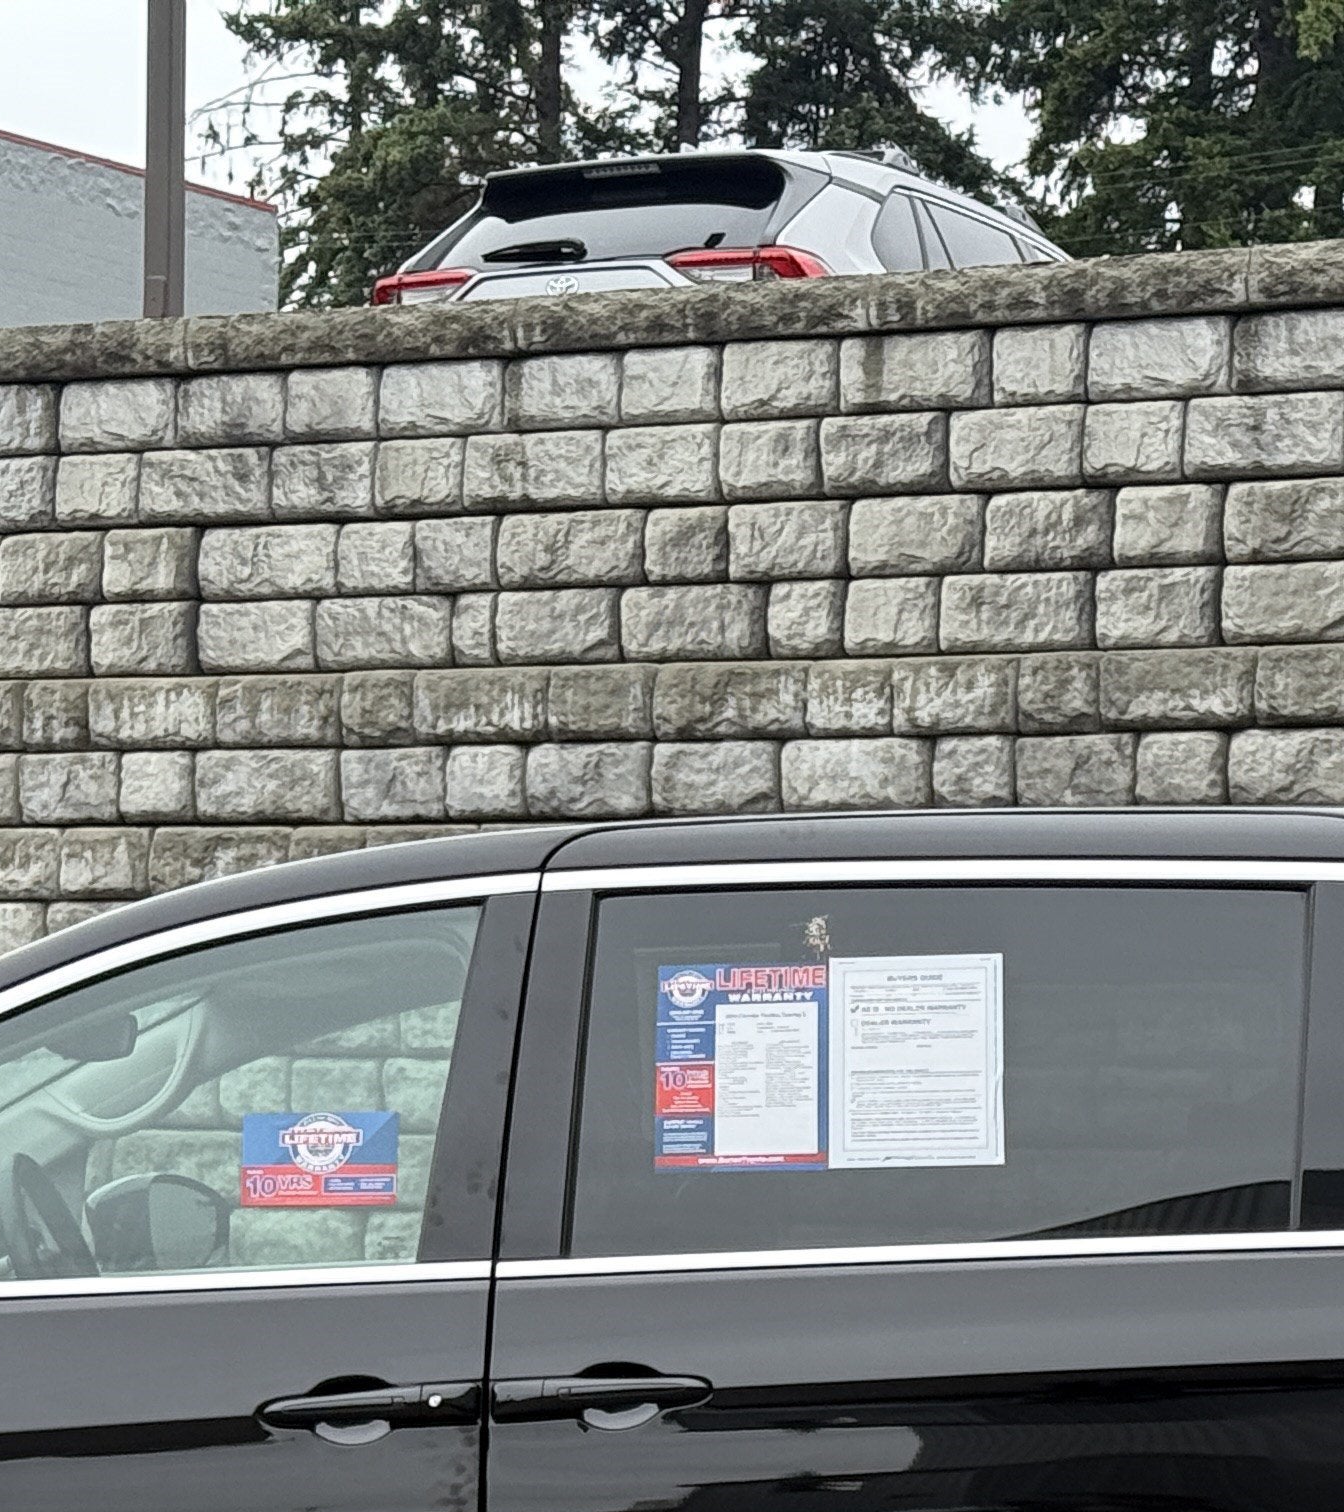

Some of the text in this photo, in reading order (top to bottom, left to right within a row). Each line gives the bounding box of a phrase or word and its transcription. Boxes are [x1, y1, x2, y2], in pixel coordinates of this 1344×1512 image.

[716, 965, 826, 990] LIFETIME
[728, 991, 813, 1003] WARRANTY
[660, 1071, 686, 1091] 10
[284, 1132, 357, 1145] LIFETIME
[246, 1175, 277, 1198] 10
